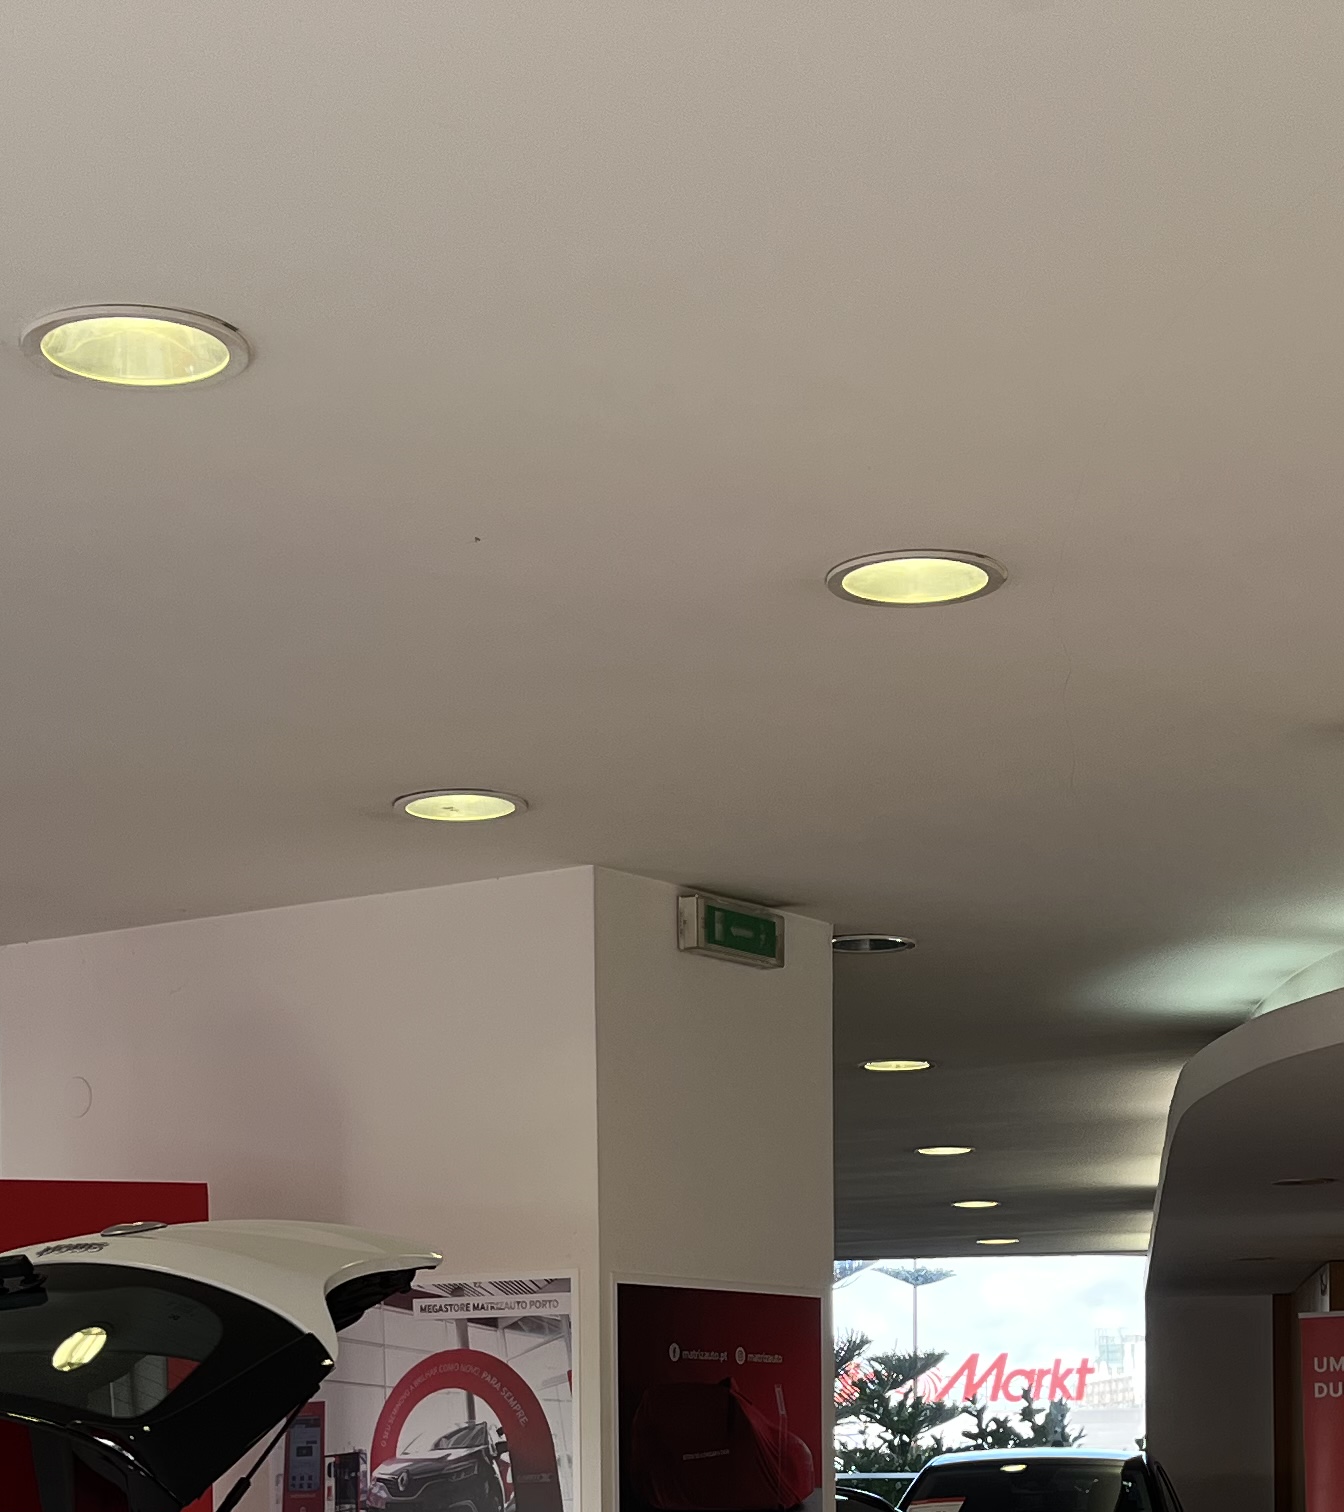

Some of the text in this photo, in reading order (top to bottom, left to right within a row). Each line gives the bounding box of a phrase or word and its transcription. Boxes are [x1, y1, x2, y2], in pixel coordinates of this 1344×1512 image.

[419, 1299, 559, 1313] MEGASTORE MATRIZAUTO PORTO
[481, 1371, 501, 1391] PARA
[935, 1354, 1095, 1401] Markt
